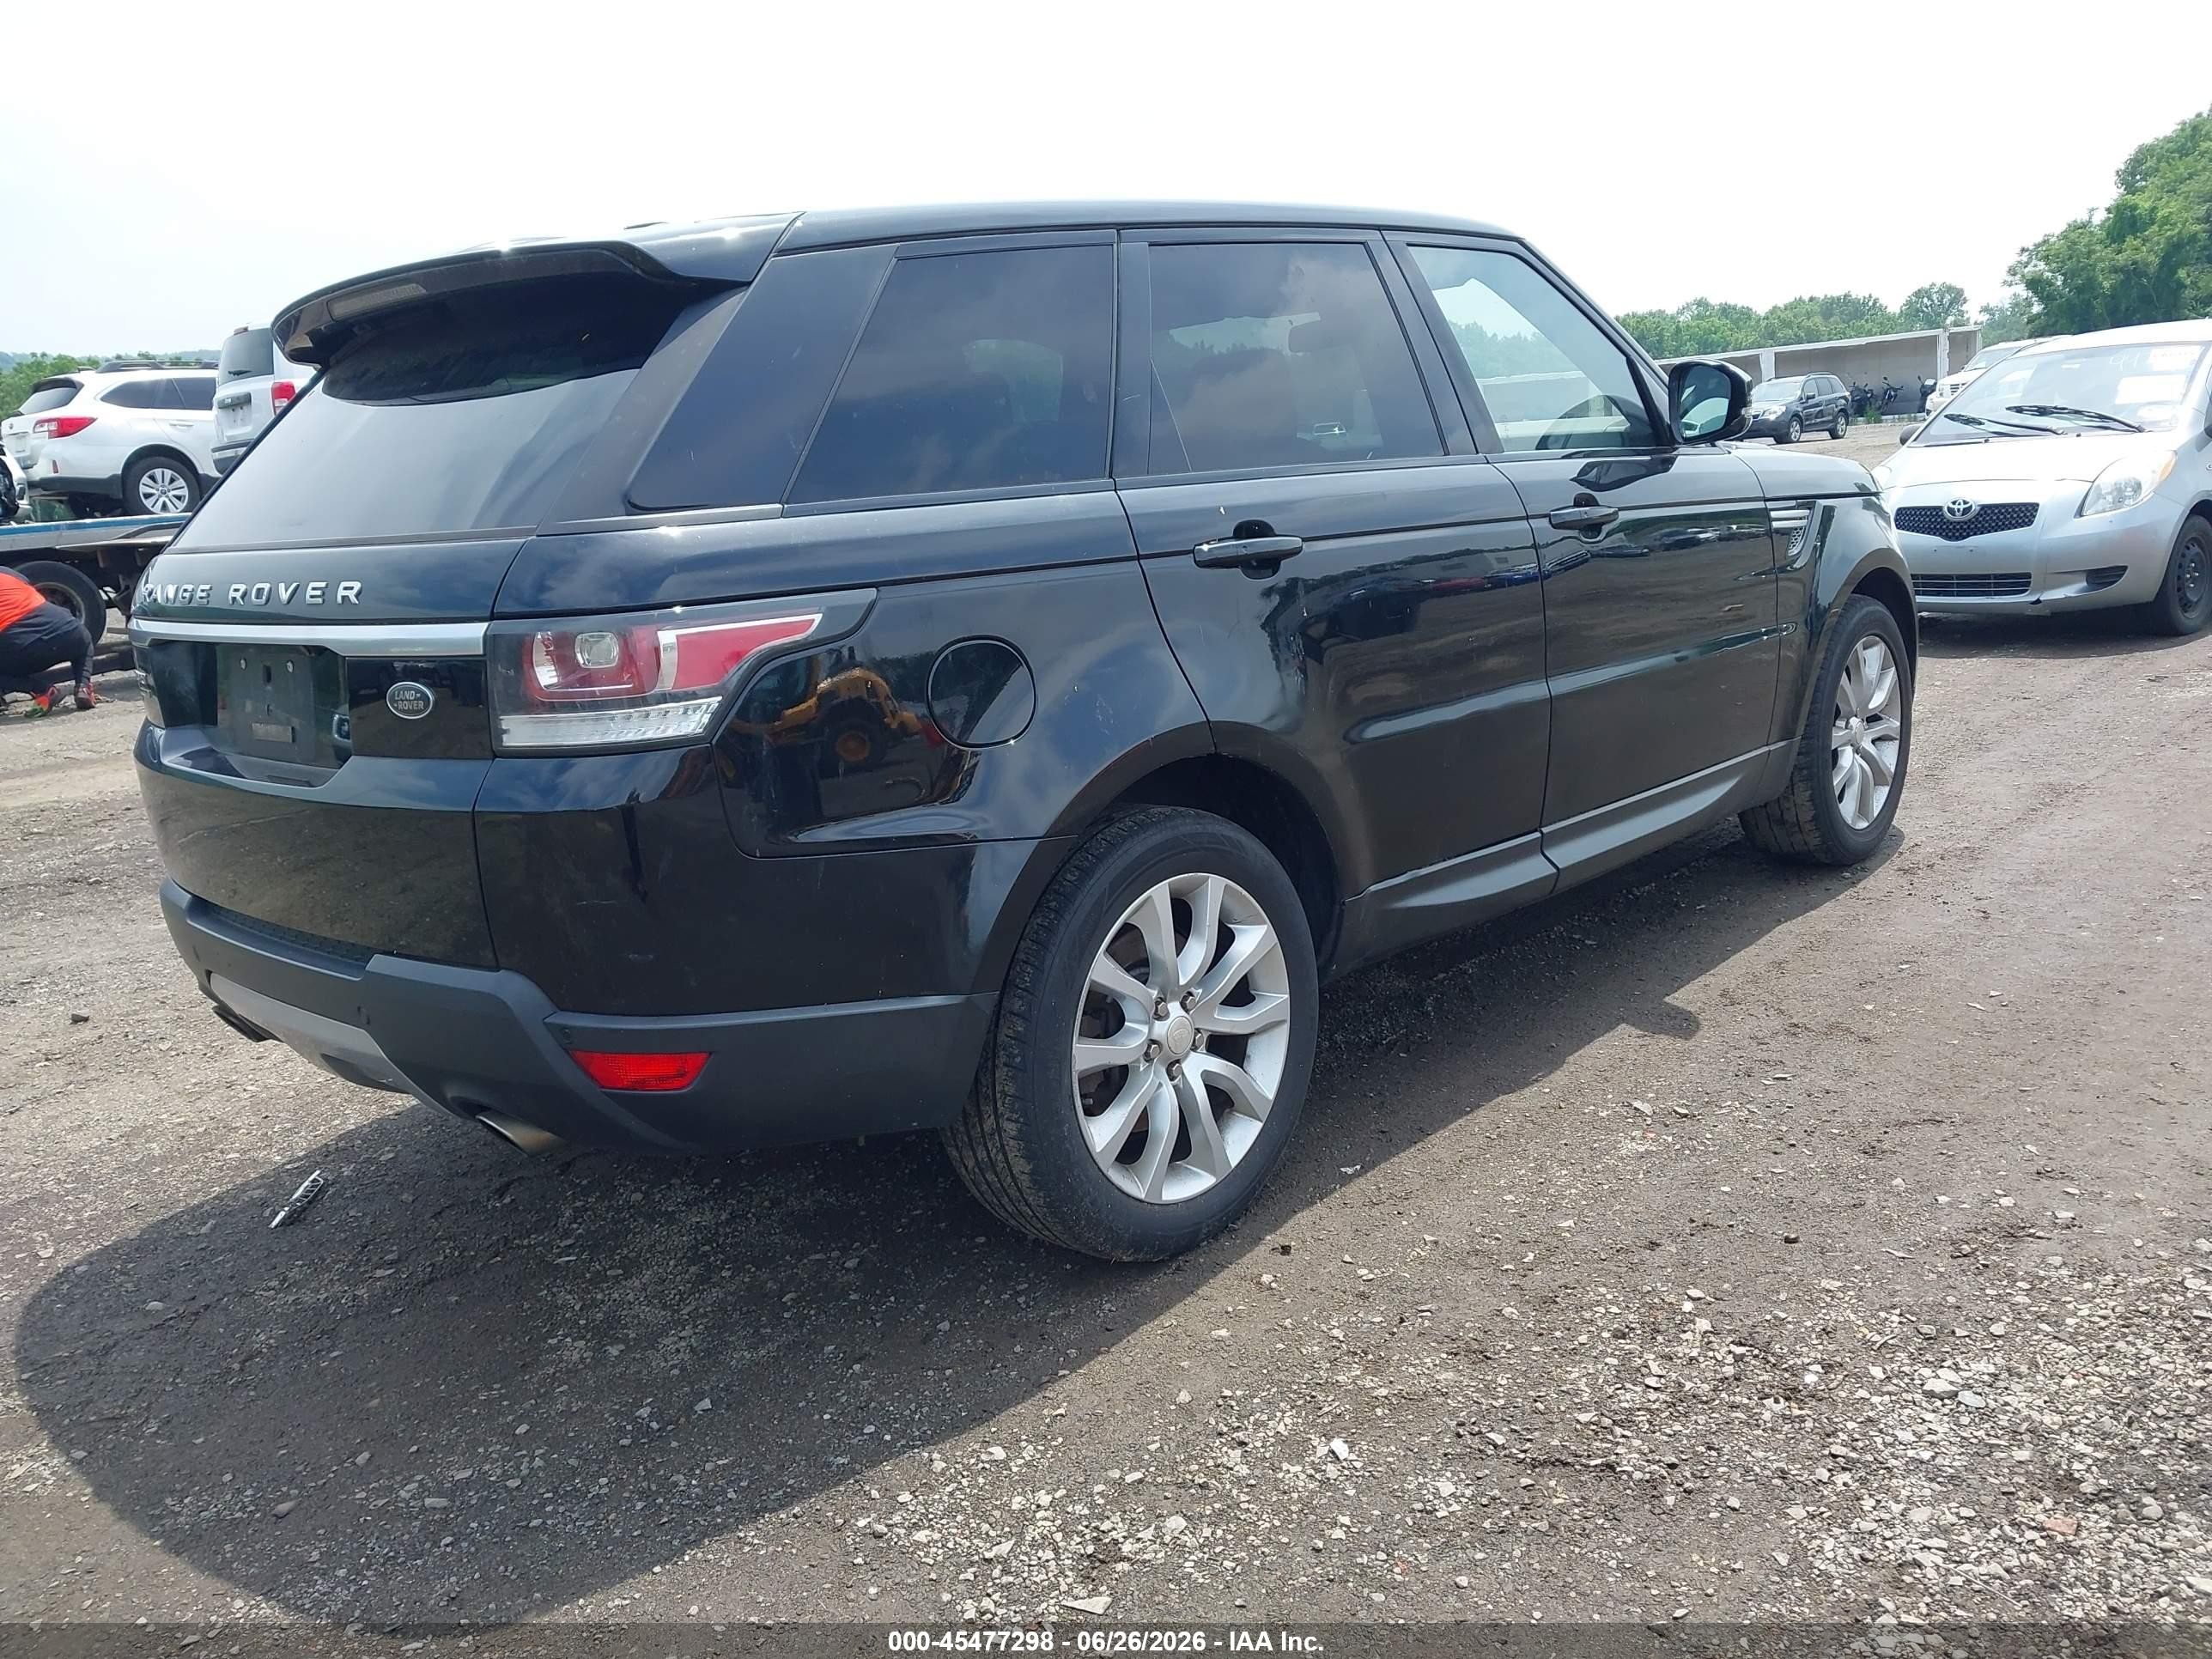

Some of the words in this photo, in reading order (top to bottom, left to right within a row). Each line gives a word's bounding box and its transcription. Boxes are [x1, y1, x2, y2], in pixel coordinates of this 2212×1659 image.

[143, 583, 213, 605] RANGE
[228, 580, 362, 605] ROVER
[395, 690, 416, 701] LAND
[398, 700, 424, 710] ROVER
